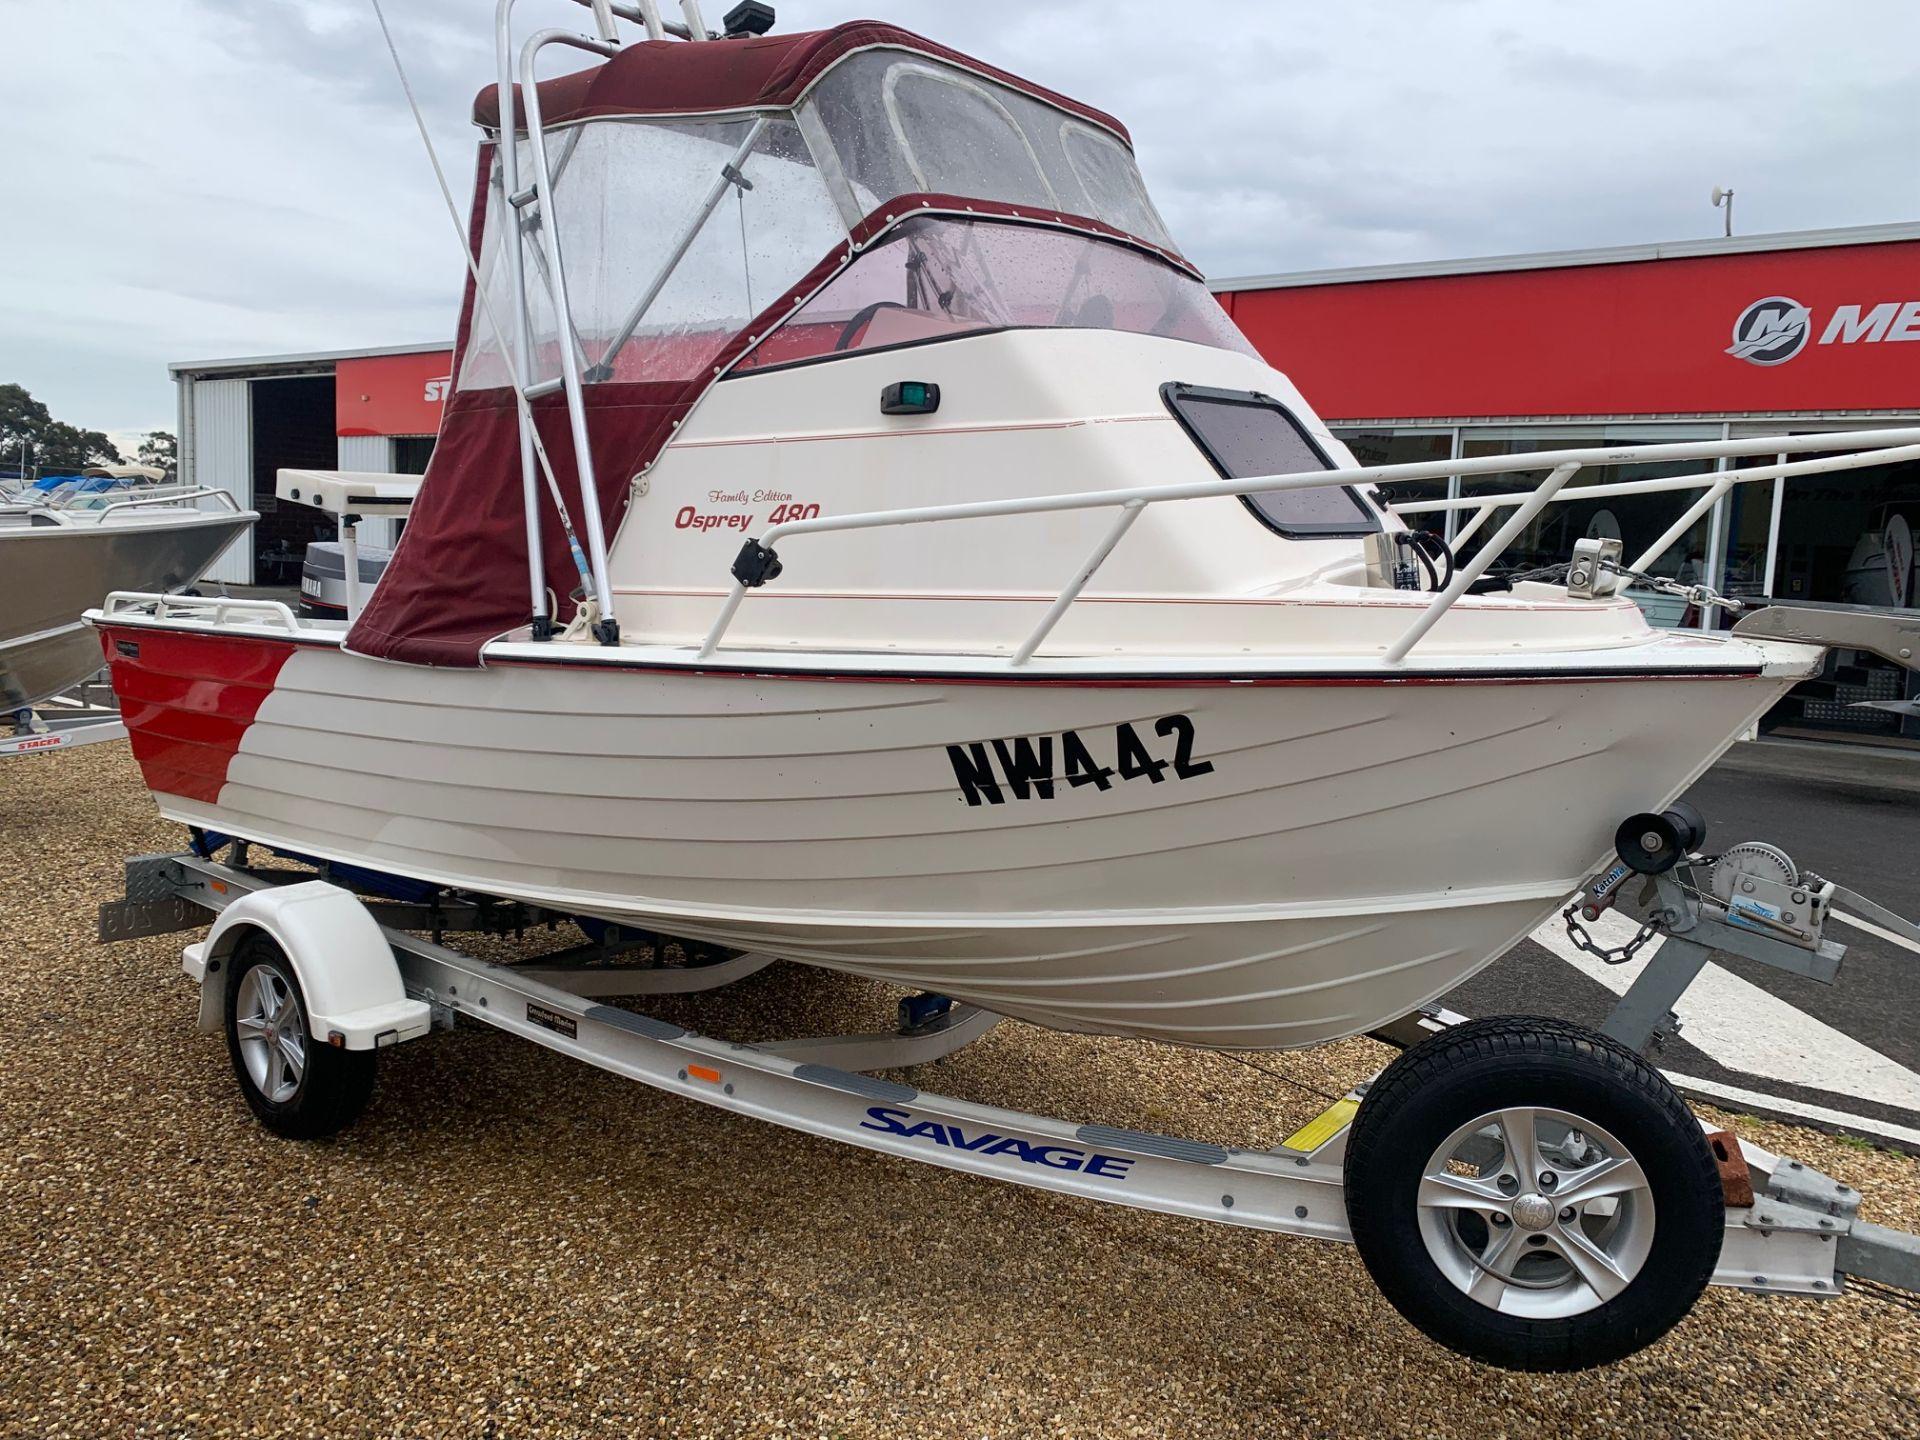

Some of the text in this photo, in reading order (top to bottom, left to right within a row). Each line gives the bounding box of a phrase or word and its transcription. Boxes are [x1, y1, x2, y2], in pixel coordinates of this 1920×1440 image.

[708, 489, 793, 505] Family Edition
[675, 506, 754, 532] Osprey
[18, 737, 61, 750] STACER
[946, 714, 1214, 806] NW442
[860, 1107, 1135, 1179] SAVAGE
